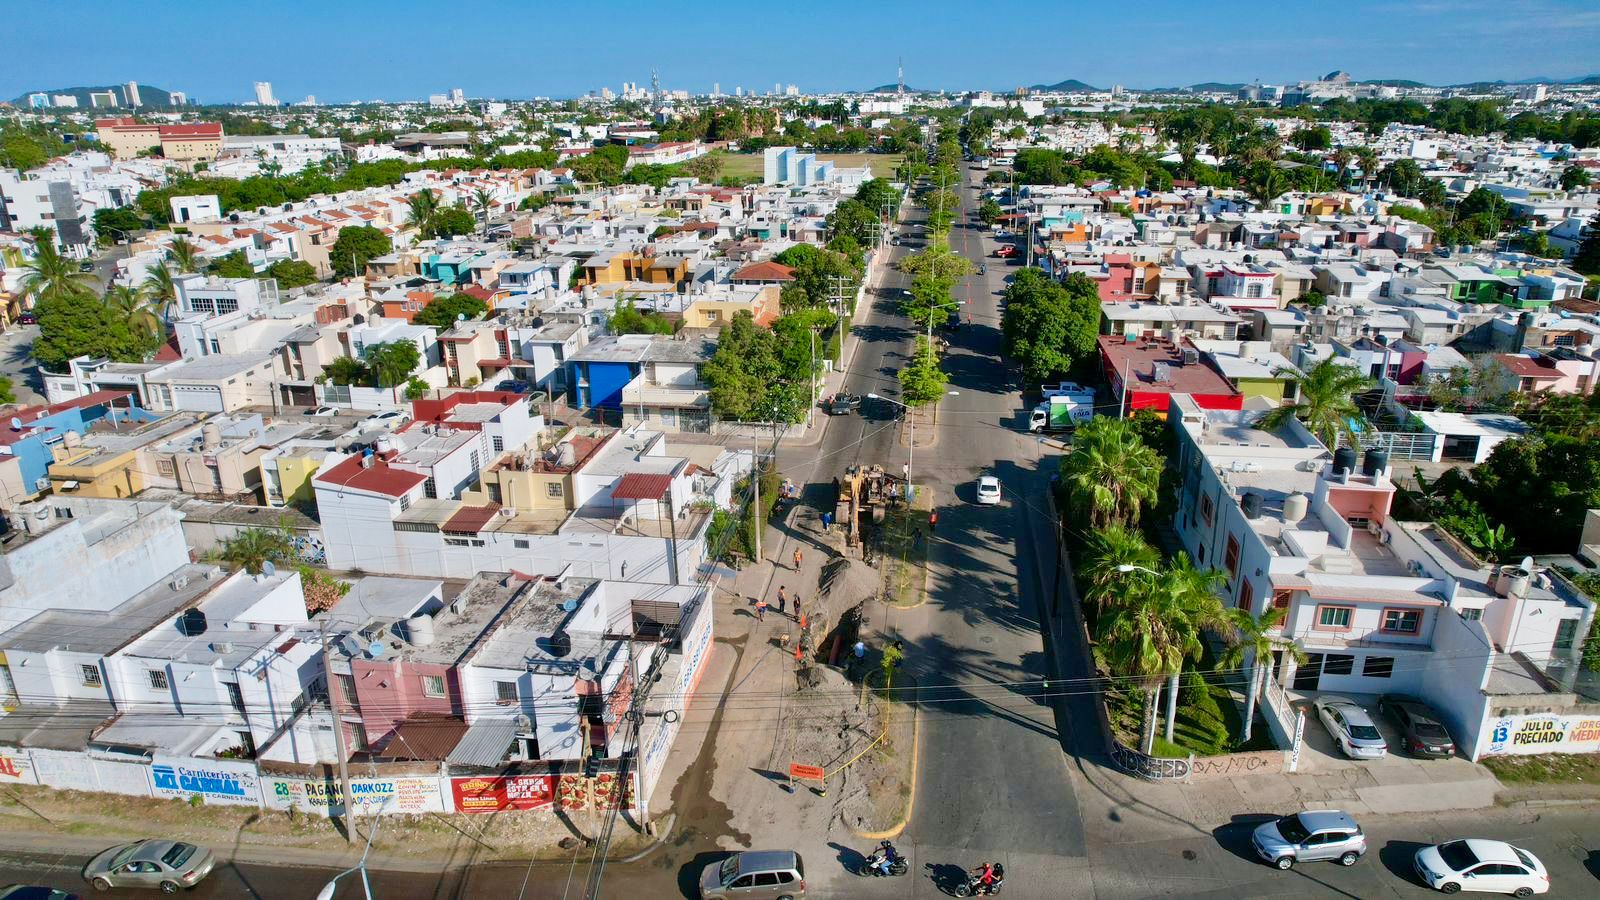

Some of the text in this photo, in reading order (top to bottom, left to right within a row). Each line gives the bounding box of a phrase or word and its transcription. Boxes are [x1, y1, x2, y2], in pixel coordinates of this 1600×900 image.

[1521, 721, 1554, 732] JULIO
[1561, 721, 1569, 730] Y
[1492, 727, 1508, 743] 13
[1513, 731, 1564, 745] PRECIADO
[179, 766, 231, 780] Carnicería
[153, 773, 179, 789] MI
[180, 775, 245, 795] CARNAL
[274, 782, 289, 796] 28
[351, 783, 394, 794] DARKOZZ
